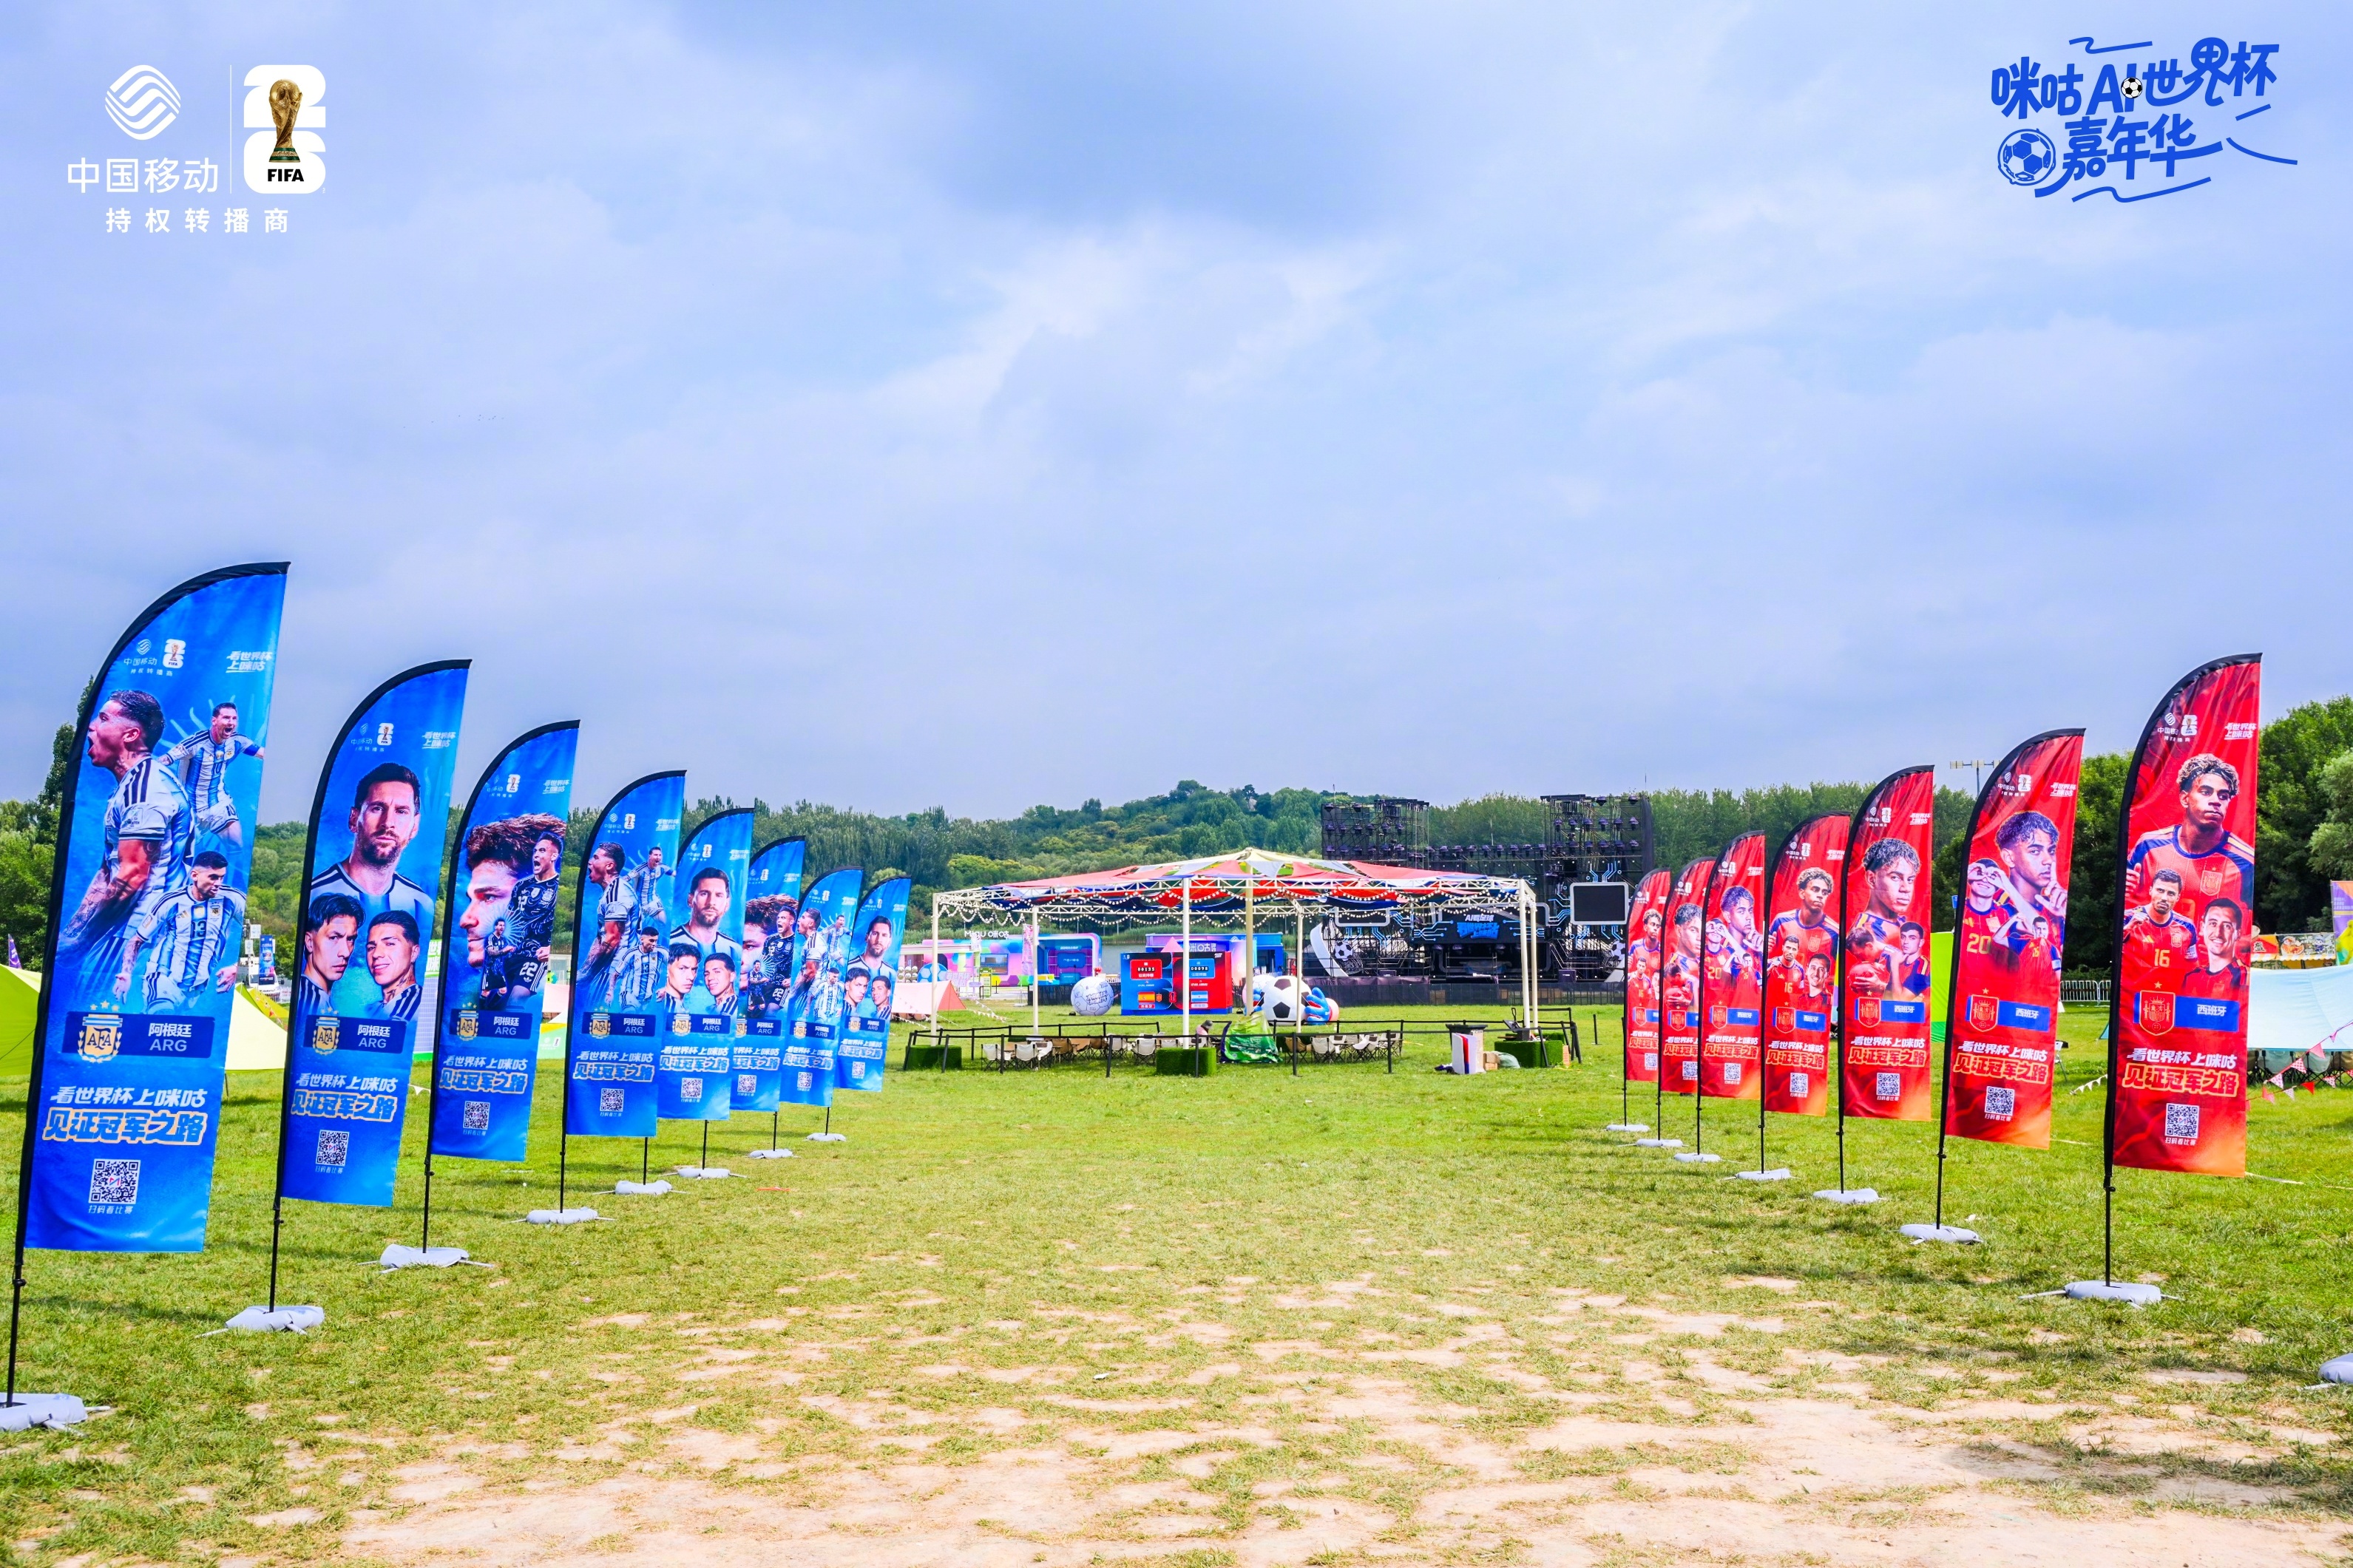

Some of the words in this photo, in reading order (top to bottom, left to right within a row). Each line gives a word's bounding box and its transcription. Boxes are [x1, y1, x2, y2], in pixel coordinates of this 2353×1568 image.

[123, 657, 158, 666] 中国移动
[226, 651, 272, 661] 看世界杯
[226, 660, 265, 672] 上咪咕
[1966, 932, 1991, 954] 20
[2154, 948, 2170, 968] 16
[520, 962, 538, 977] 22
[1707, 967, 1722, 980] 20
[1784, 982, 1793, 993] 16
[1894, 1005, 1914, 1013] 西班牙
[2015, 1008, 2039, 1019] 西班牙
[2197, 1004, 2227, 1017] 西班牙
[494, 1017, 519, 1026] 阿根廷
[623, 1018, 645, 1026] 阿根廷
[148, 1022, 192, 1038] 阿根廷
[357, 1024, 390, 1037] 阿根廷
[495, 1026, 517, 1035] ARG
[88, 1028, 112, 1051] AFA
[149, 1039, 188, 1052] ARG
[358, 1038, 387, 1048] ARG
[1850, 1036, 1926, 1048] 看世界杯上咪咕
[576, 1051, 654, 1062] 看世界杯上咪咕
[660, 1045, 729, 1056] 看世界杯上咪咕
[1848, 1046, 1927, 1068] 见证冠军之路
[1958, 1040, 2048, 1062] 看世界杯上咪咕
[443, 1055, 528, 1071] 看世界杯上咪咕
[1766, 1050, 1825, 1070] 见证冠军之路
[2127, 1048, 2238, 1069] 看世界杯上咪咕
[572, 1062, 655, 1082] 见证冠军之路
[1953, 1052, 2049, 1085] 见证冠军之路
[296, 1072, 398, 1093] 看世界杯上咪咕
[439, 1068, 528, 1094] 见证冠军之路
[2122, 1062, 2240, 1098] 见证冠军之路
[50, 1085, 208, 1107] 看世界杯上咪咕
[291, 1088, 398, 1122] 见证冠军之路
[42, 1107, 208, 1145] 见证冠军之路
[2164, 1136, 2196, 1146] 扫码看比赛
[88, 1204, 133, 1215] 扫码看比赛
